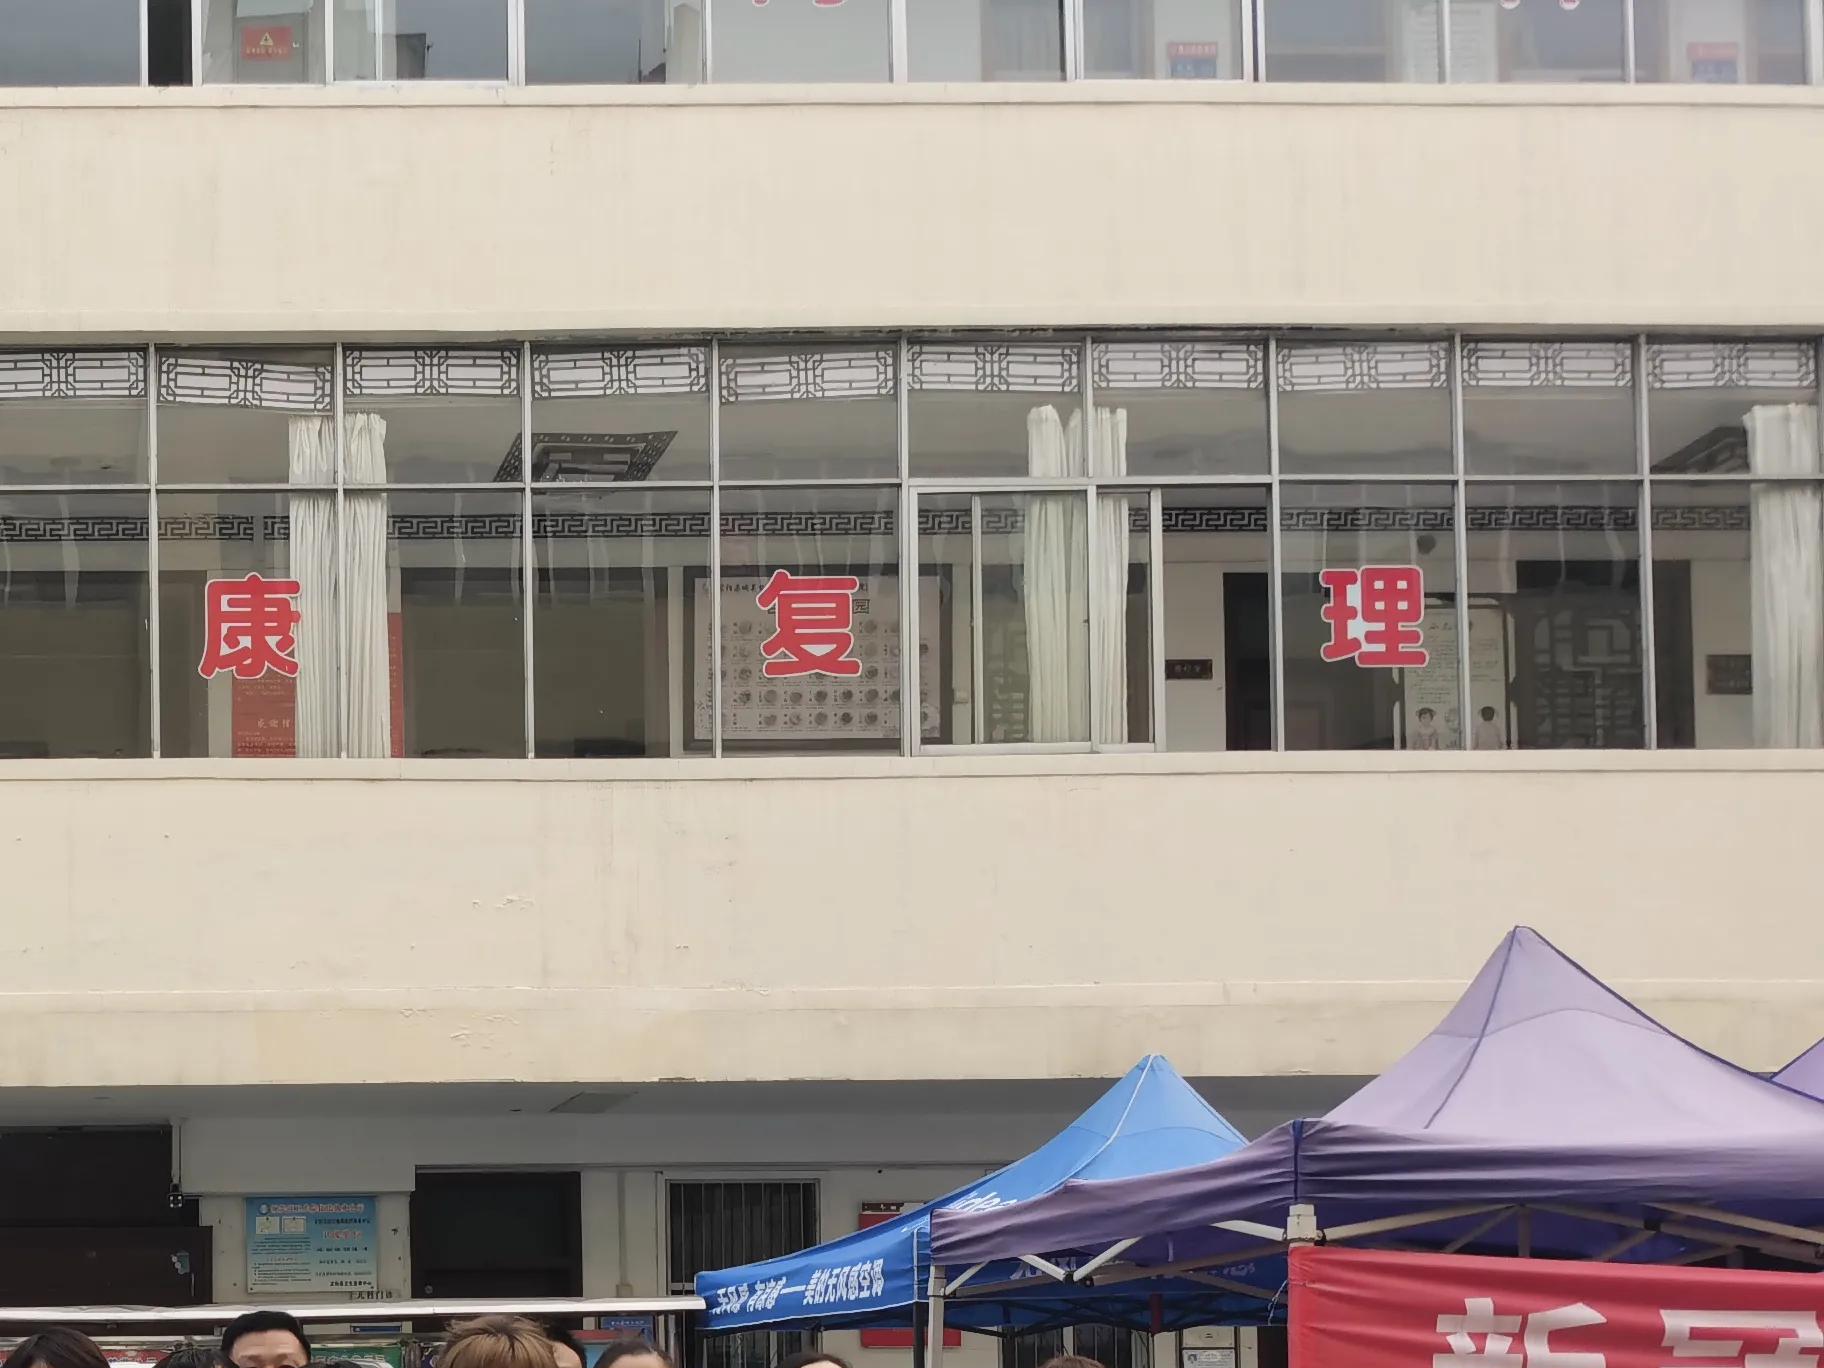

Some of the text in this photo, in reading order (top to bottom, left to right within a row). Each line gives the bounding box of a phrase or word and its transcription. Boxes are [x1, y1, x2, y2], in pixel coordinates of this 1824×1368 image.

[198, 572, 303, 680] 康
[756, 568, 863, 678] 复
[1319, 564, 1430, 668] 理
